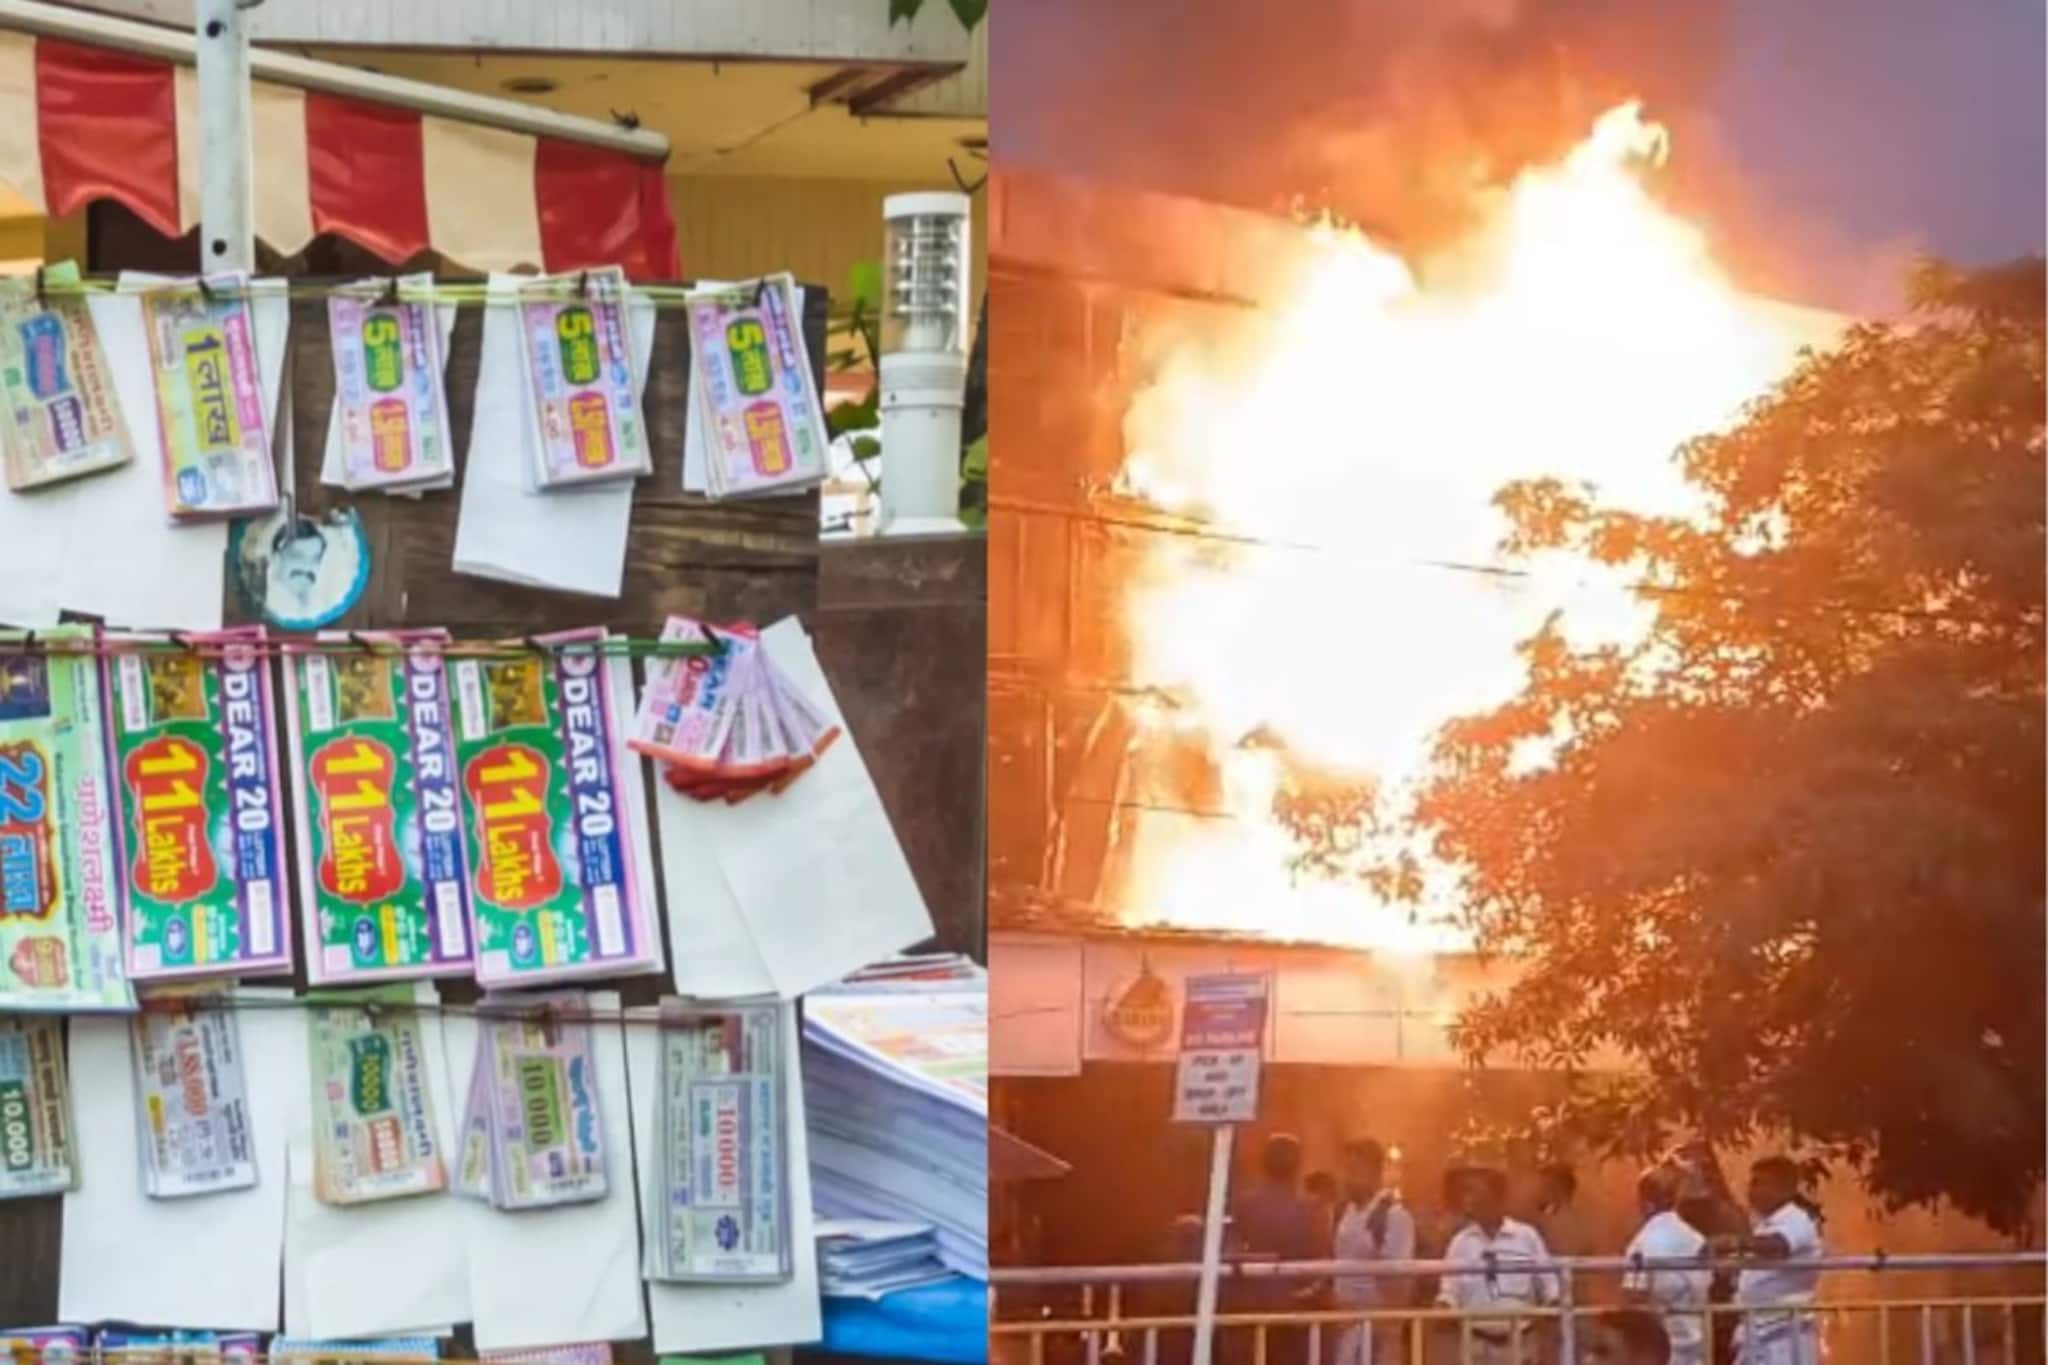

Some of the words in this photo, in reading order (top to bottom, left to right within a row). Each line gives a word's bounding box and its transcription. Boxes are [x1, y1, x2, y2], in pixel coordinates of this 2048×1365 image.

[187, 335, 221, 354] 1
[364, 317, 398, 343] 5
[558, 309, 593, 338] 5
[727, 321, 763, 349] 5
[199, 354, 230, 445] लाख
[223, 673, 255, 780] DEAR
[410, 673, 442, 781] DEAR
[563, 677, 597, 785] DEAR
[0, 751, 44, 825] 22
[140, 744, 201, 810] 11
[236, 784, 269, 833] 20
[326, 744, 385, 811] 11
[422, 788, 455, 833] 20
[480, 752, 541, 820] 11
[579, 791, 614, 837] 20
[145, 814, 189, 895] Lakhs
[332, 815, 371, 894] Lakhs
[488, 823, 525, 901] Lakhs
